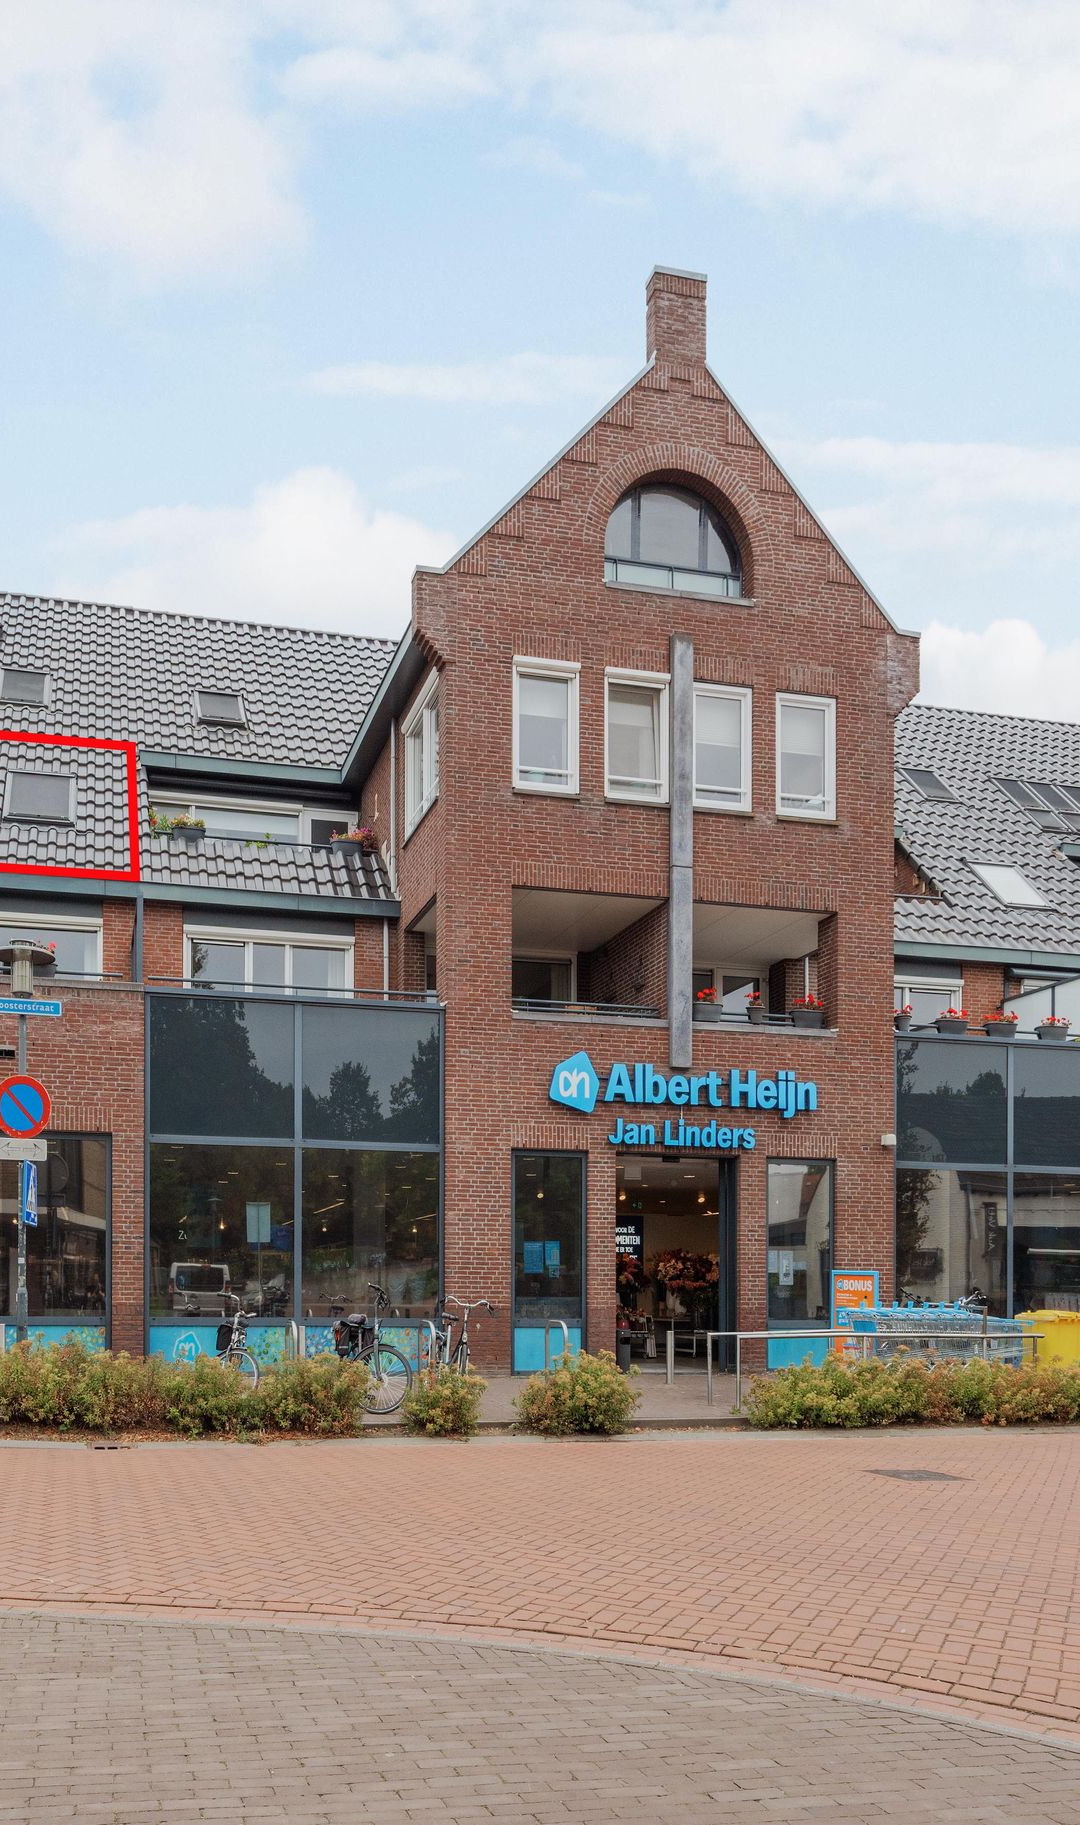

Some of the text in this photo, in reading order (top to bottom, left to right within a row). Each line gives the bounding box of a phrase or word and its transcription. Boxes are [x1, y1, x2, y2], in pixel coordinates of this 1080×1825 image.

[604, 1063, 818, 1119] Albert Heijn
[607, 1118, 757, 1150] Jan Linders
[843, 1279, 873, 1292] BONUS
